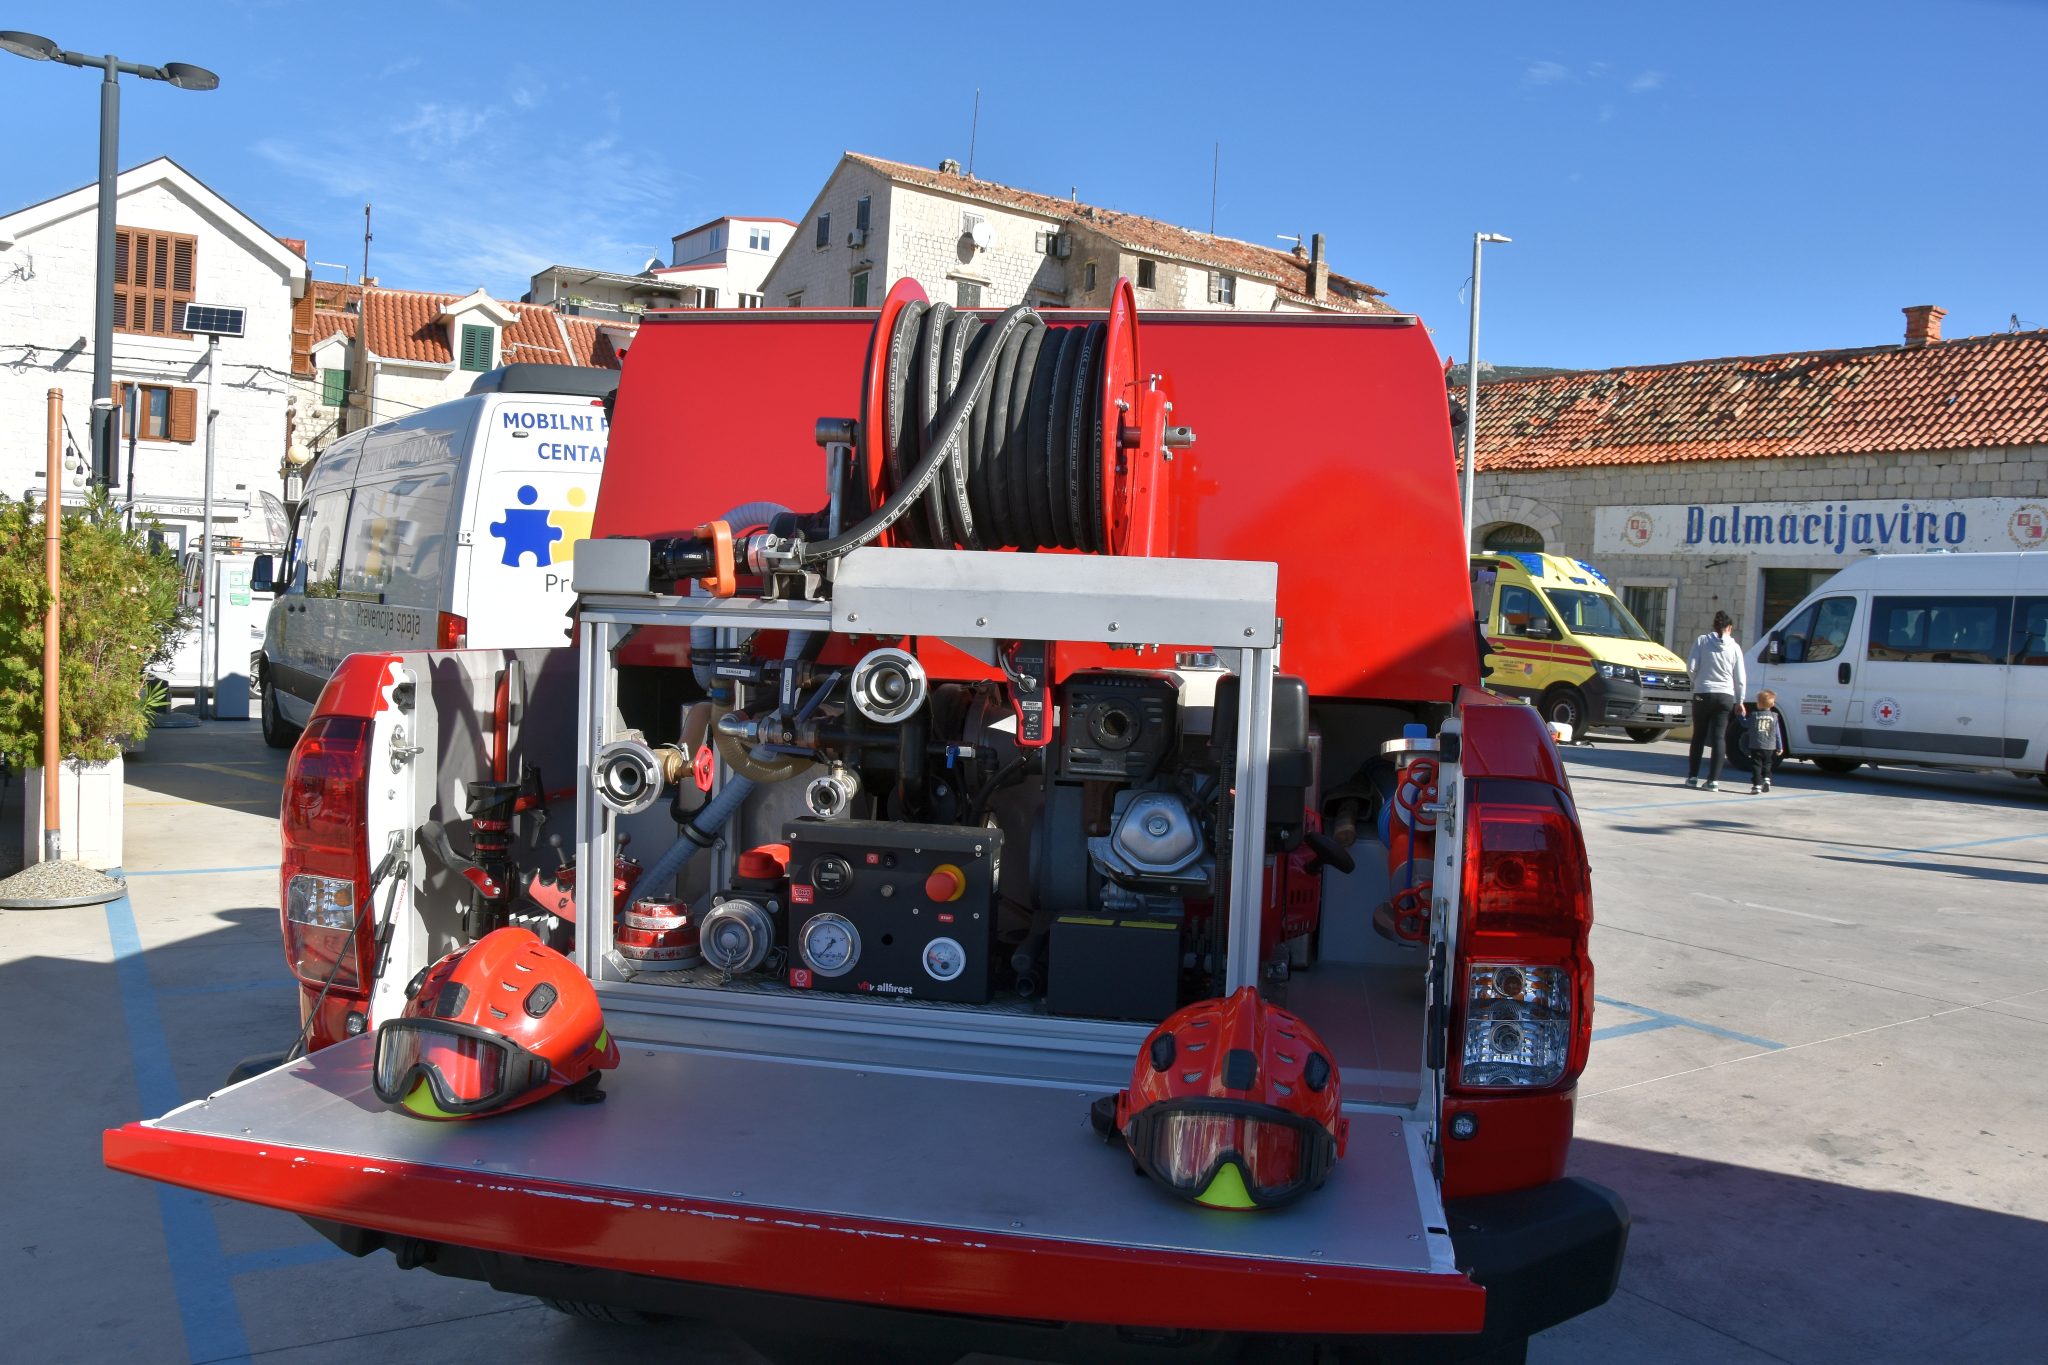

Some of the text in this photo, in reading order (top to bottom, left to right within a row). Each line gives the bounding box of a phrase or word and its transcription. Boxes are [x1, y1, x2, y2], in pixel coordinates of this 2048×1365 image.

[503, 413, 594, 432] MOBILNI
[538, 442, 606, 463] CENTA
[171, 505, 205, 516] CREA
[859, 520, 888, 544] UNIVERSAL
[889, 508, 900, 520] 2TE
[1685, 503, 1967, 554] Dalmacijavino
[545, 574, 575, 593] Pr
[357, 603, 421, 640] Prevencija spaja
